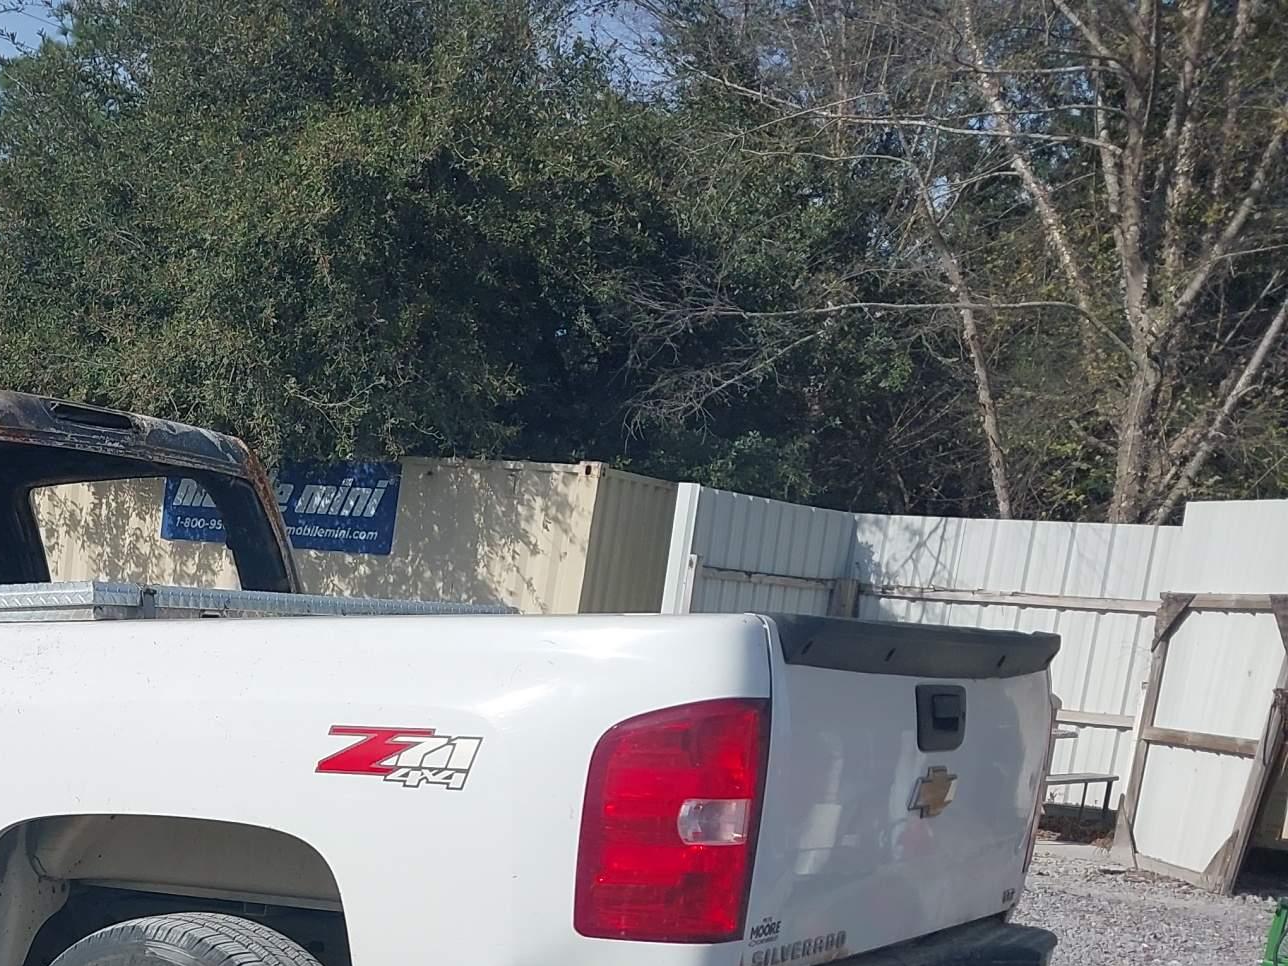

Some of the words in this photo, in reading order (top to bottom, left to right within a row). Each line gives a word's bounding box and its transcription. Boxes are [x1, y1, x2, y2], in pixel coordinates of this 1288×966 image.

[295, 478, 389, 517] mini
[176, 516, 225, 530] 1-800-95
[315, 725, 483, 776] Z71
[750, 920, 781, 940] MOORE
